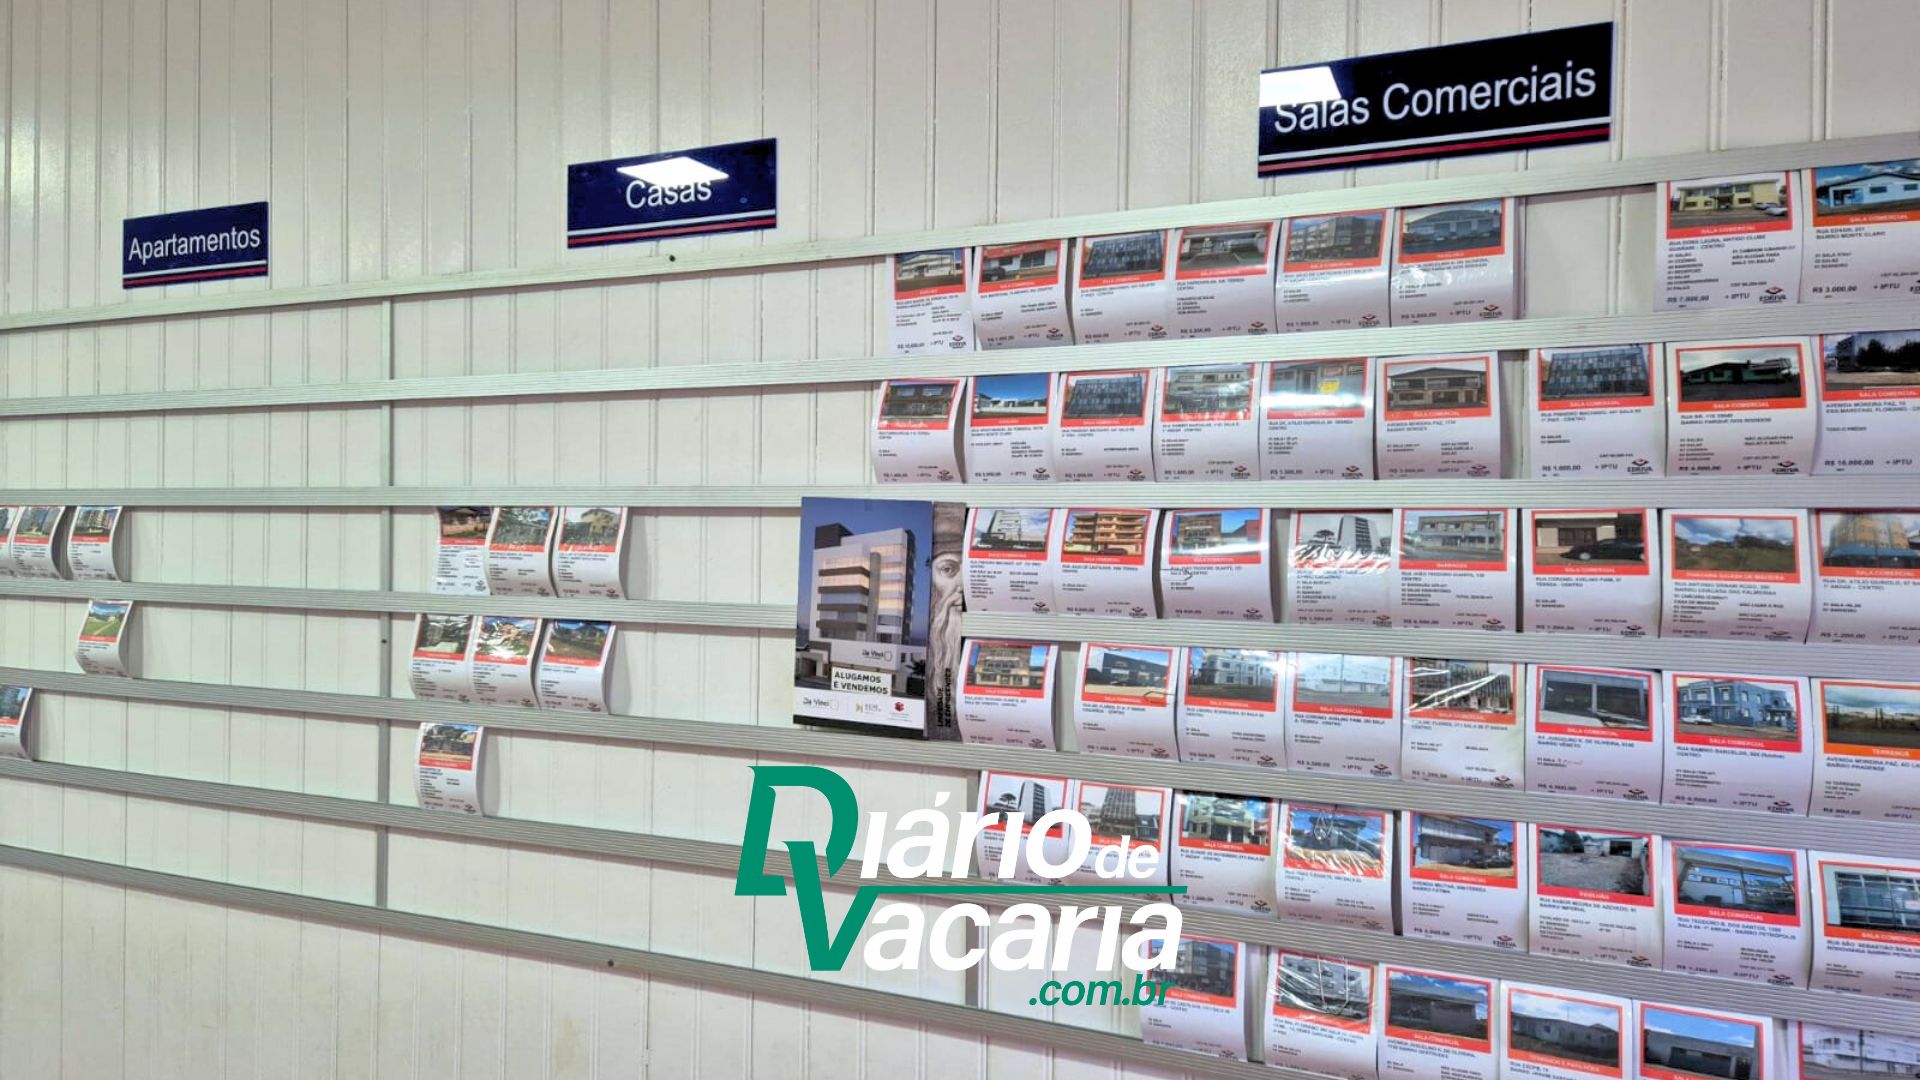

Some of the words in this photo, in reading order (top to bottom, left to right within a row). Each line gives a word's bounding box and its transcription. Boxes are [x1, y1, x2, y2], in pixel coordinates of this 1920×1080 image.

[1274, 97, 1370, 133] Salas
[1383, 60, 1597, 120] Comerciais
[624, 180, 712, 209] Casas
[128, 226, 261, 266] Apartamentos
[835, 671, 882, 684] ALUGAMOS
[841, 681, 889, 695] VENDEMOS
